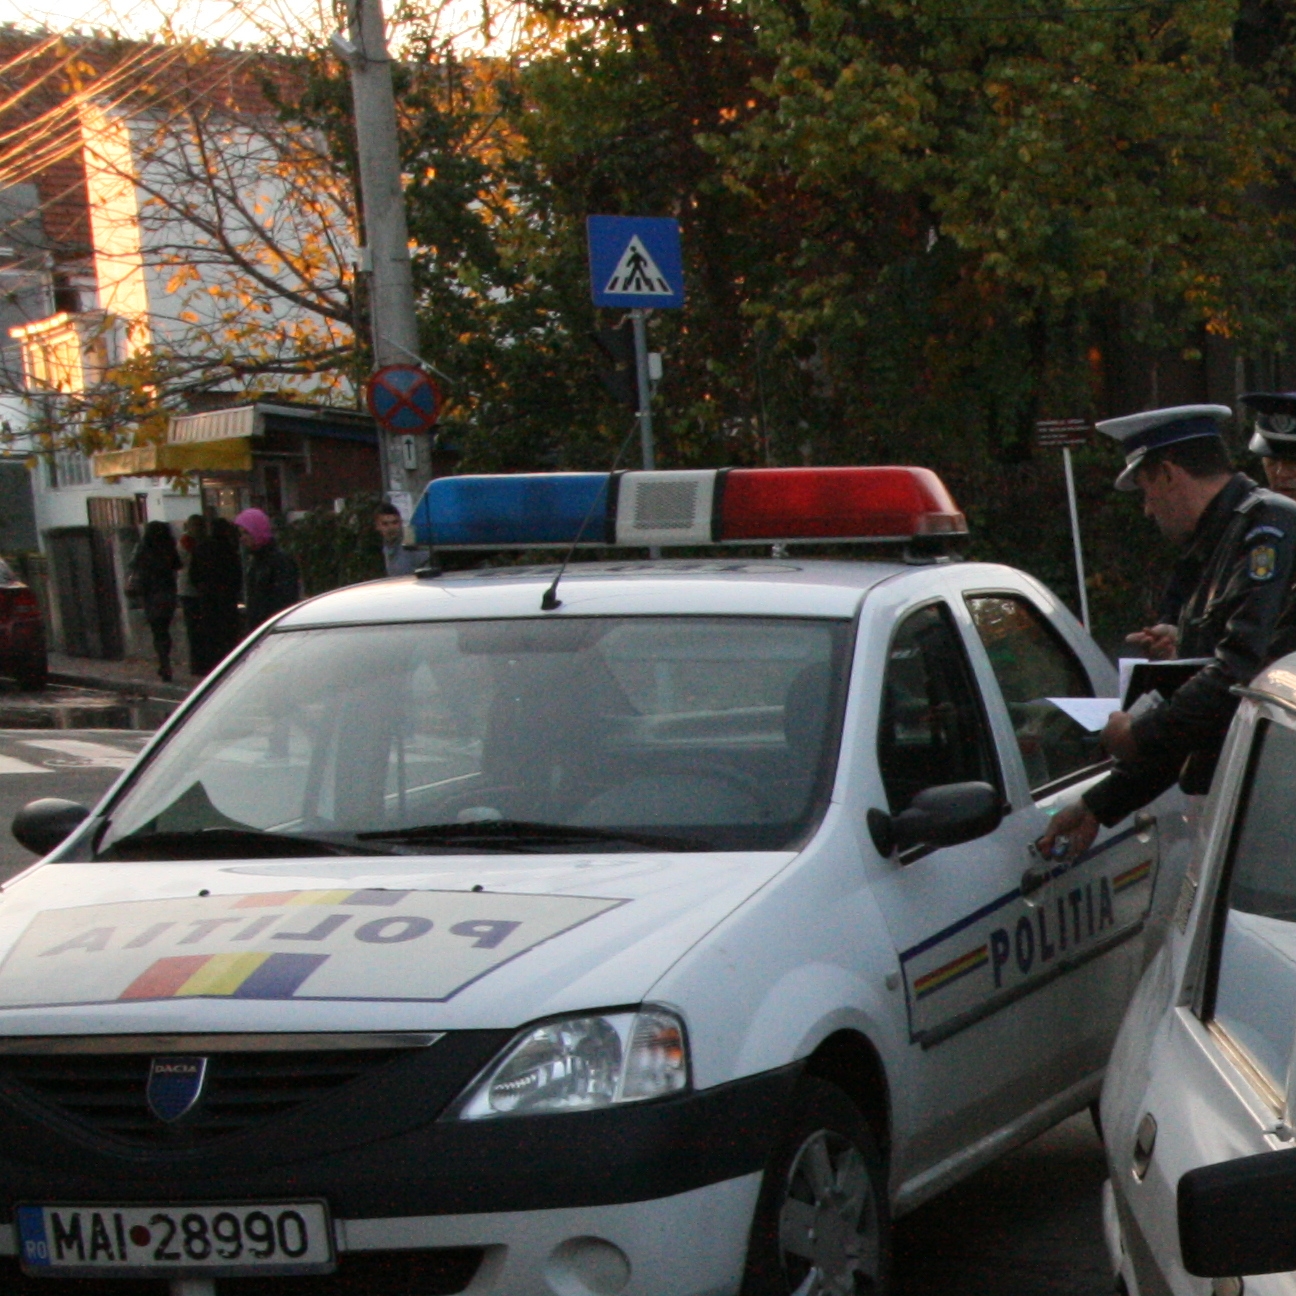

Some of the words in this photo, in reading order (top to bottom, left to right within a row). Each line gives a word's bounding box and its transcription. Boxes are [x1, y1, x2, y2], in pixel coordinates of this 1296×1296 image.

[990, 875, 1114, 988] POLITIA
[154, 1064, 197, 1074] DACIA
[25, 1239, 48, 1260] RO
[51, 1211, 128, 1262] MAI
[148, 1209, 309, 1261] 28990
